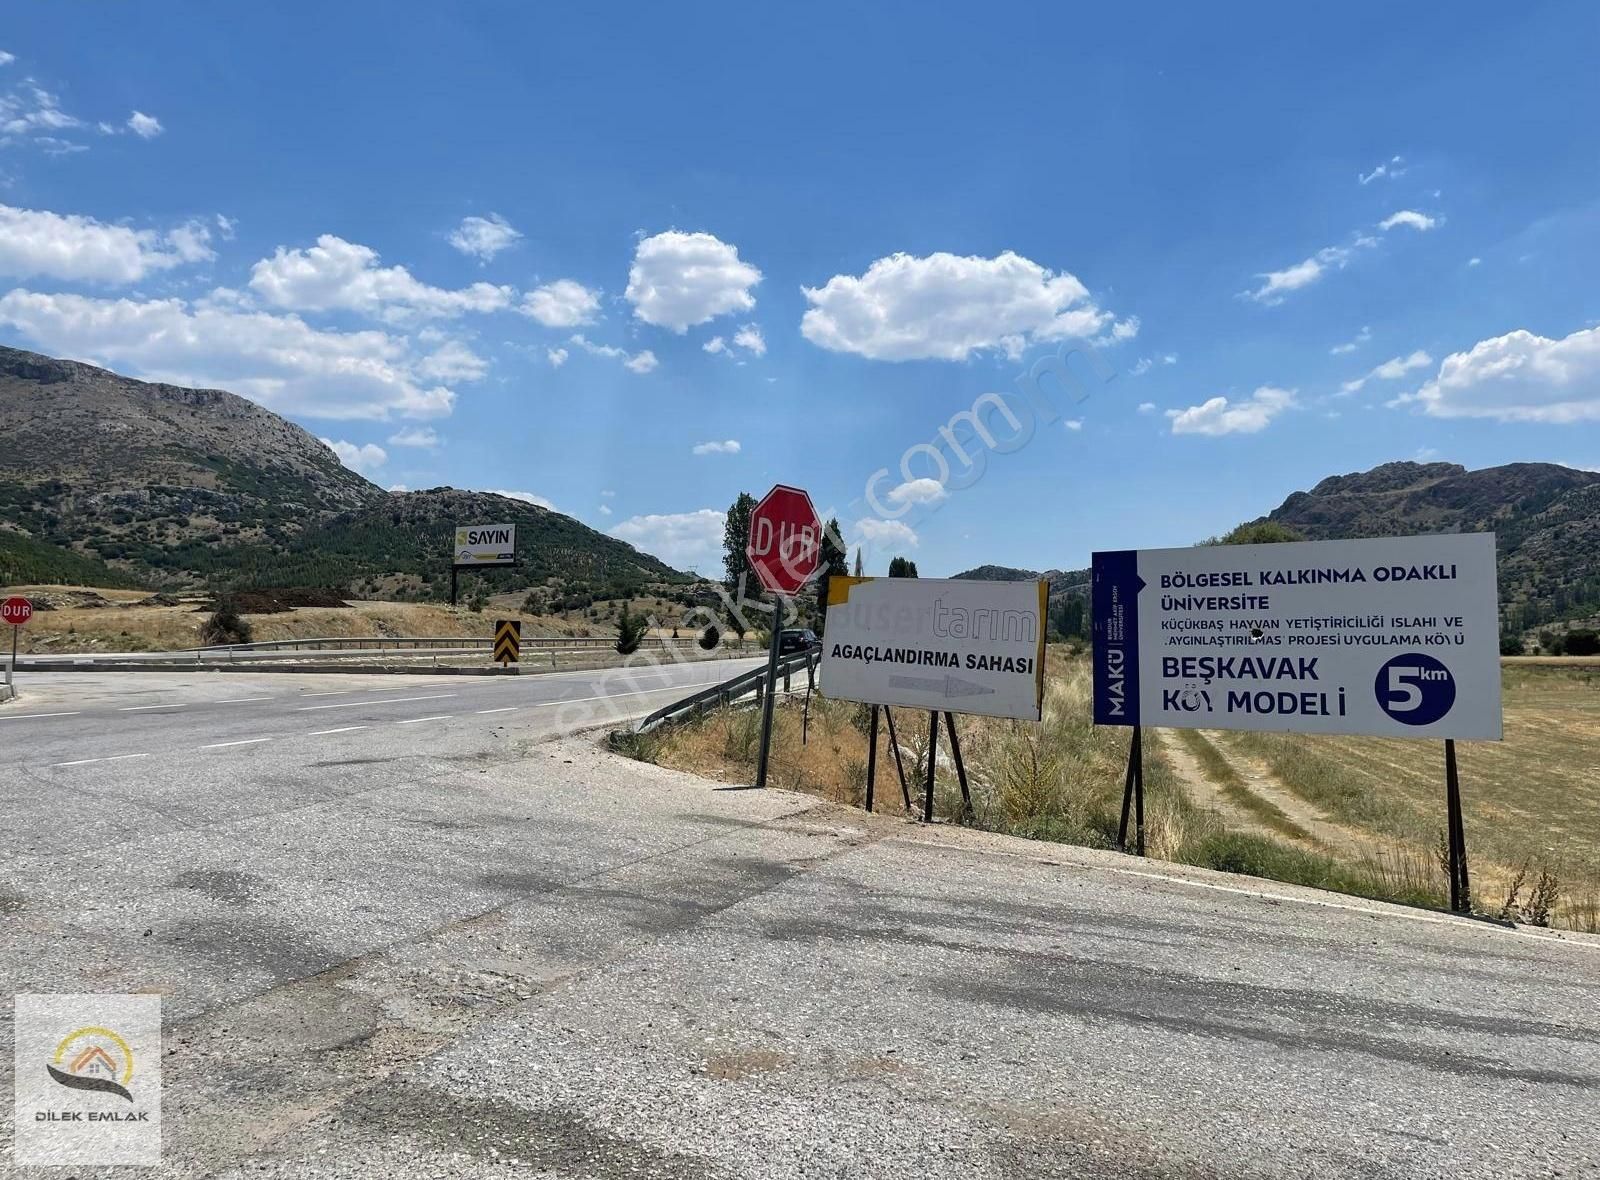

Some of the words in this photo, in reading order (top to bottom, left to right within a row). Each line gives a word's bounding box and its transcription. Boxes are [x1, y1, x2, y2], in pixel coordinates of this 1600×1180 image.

[468, 529, 510, 545] SAYIN
[755, 516, 815, 564] DUR
[1160, 571, 1253, 588] BÖLGESEL
[1259, 567, 1367, 585] KALKINMA
[1373, 564, 1457, 582] ODAKLI
[3, 605, 30, 617] DUR
[1161, 593, 1270, 611] ÜNİVERSİTE
[1161, 618, 1224, 632] KÜÇÜKBAŞ
[1229, 619, 1280, 630] HAYVAN
[1286, 615, 1384, 631] YETİŞTİRİCİLİĞİ
[1391, 616, 1437, 628] ISLAHI
[1444, 616, 1464, 627] VE
[1288, 633, 1341, 646] PROJESİ
[1343, 634, 1422, 646] UYGULAMA
[965, 653, 1034, 674] SAHASI
[1162, 656, 1319, 684] BEŞKAVAK
[1108, 650, 1125, 716] MAKÜ
